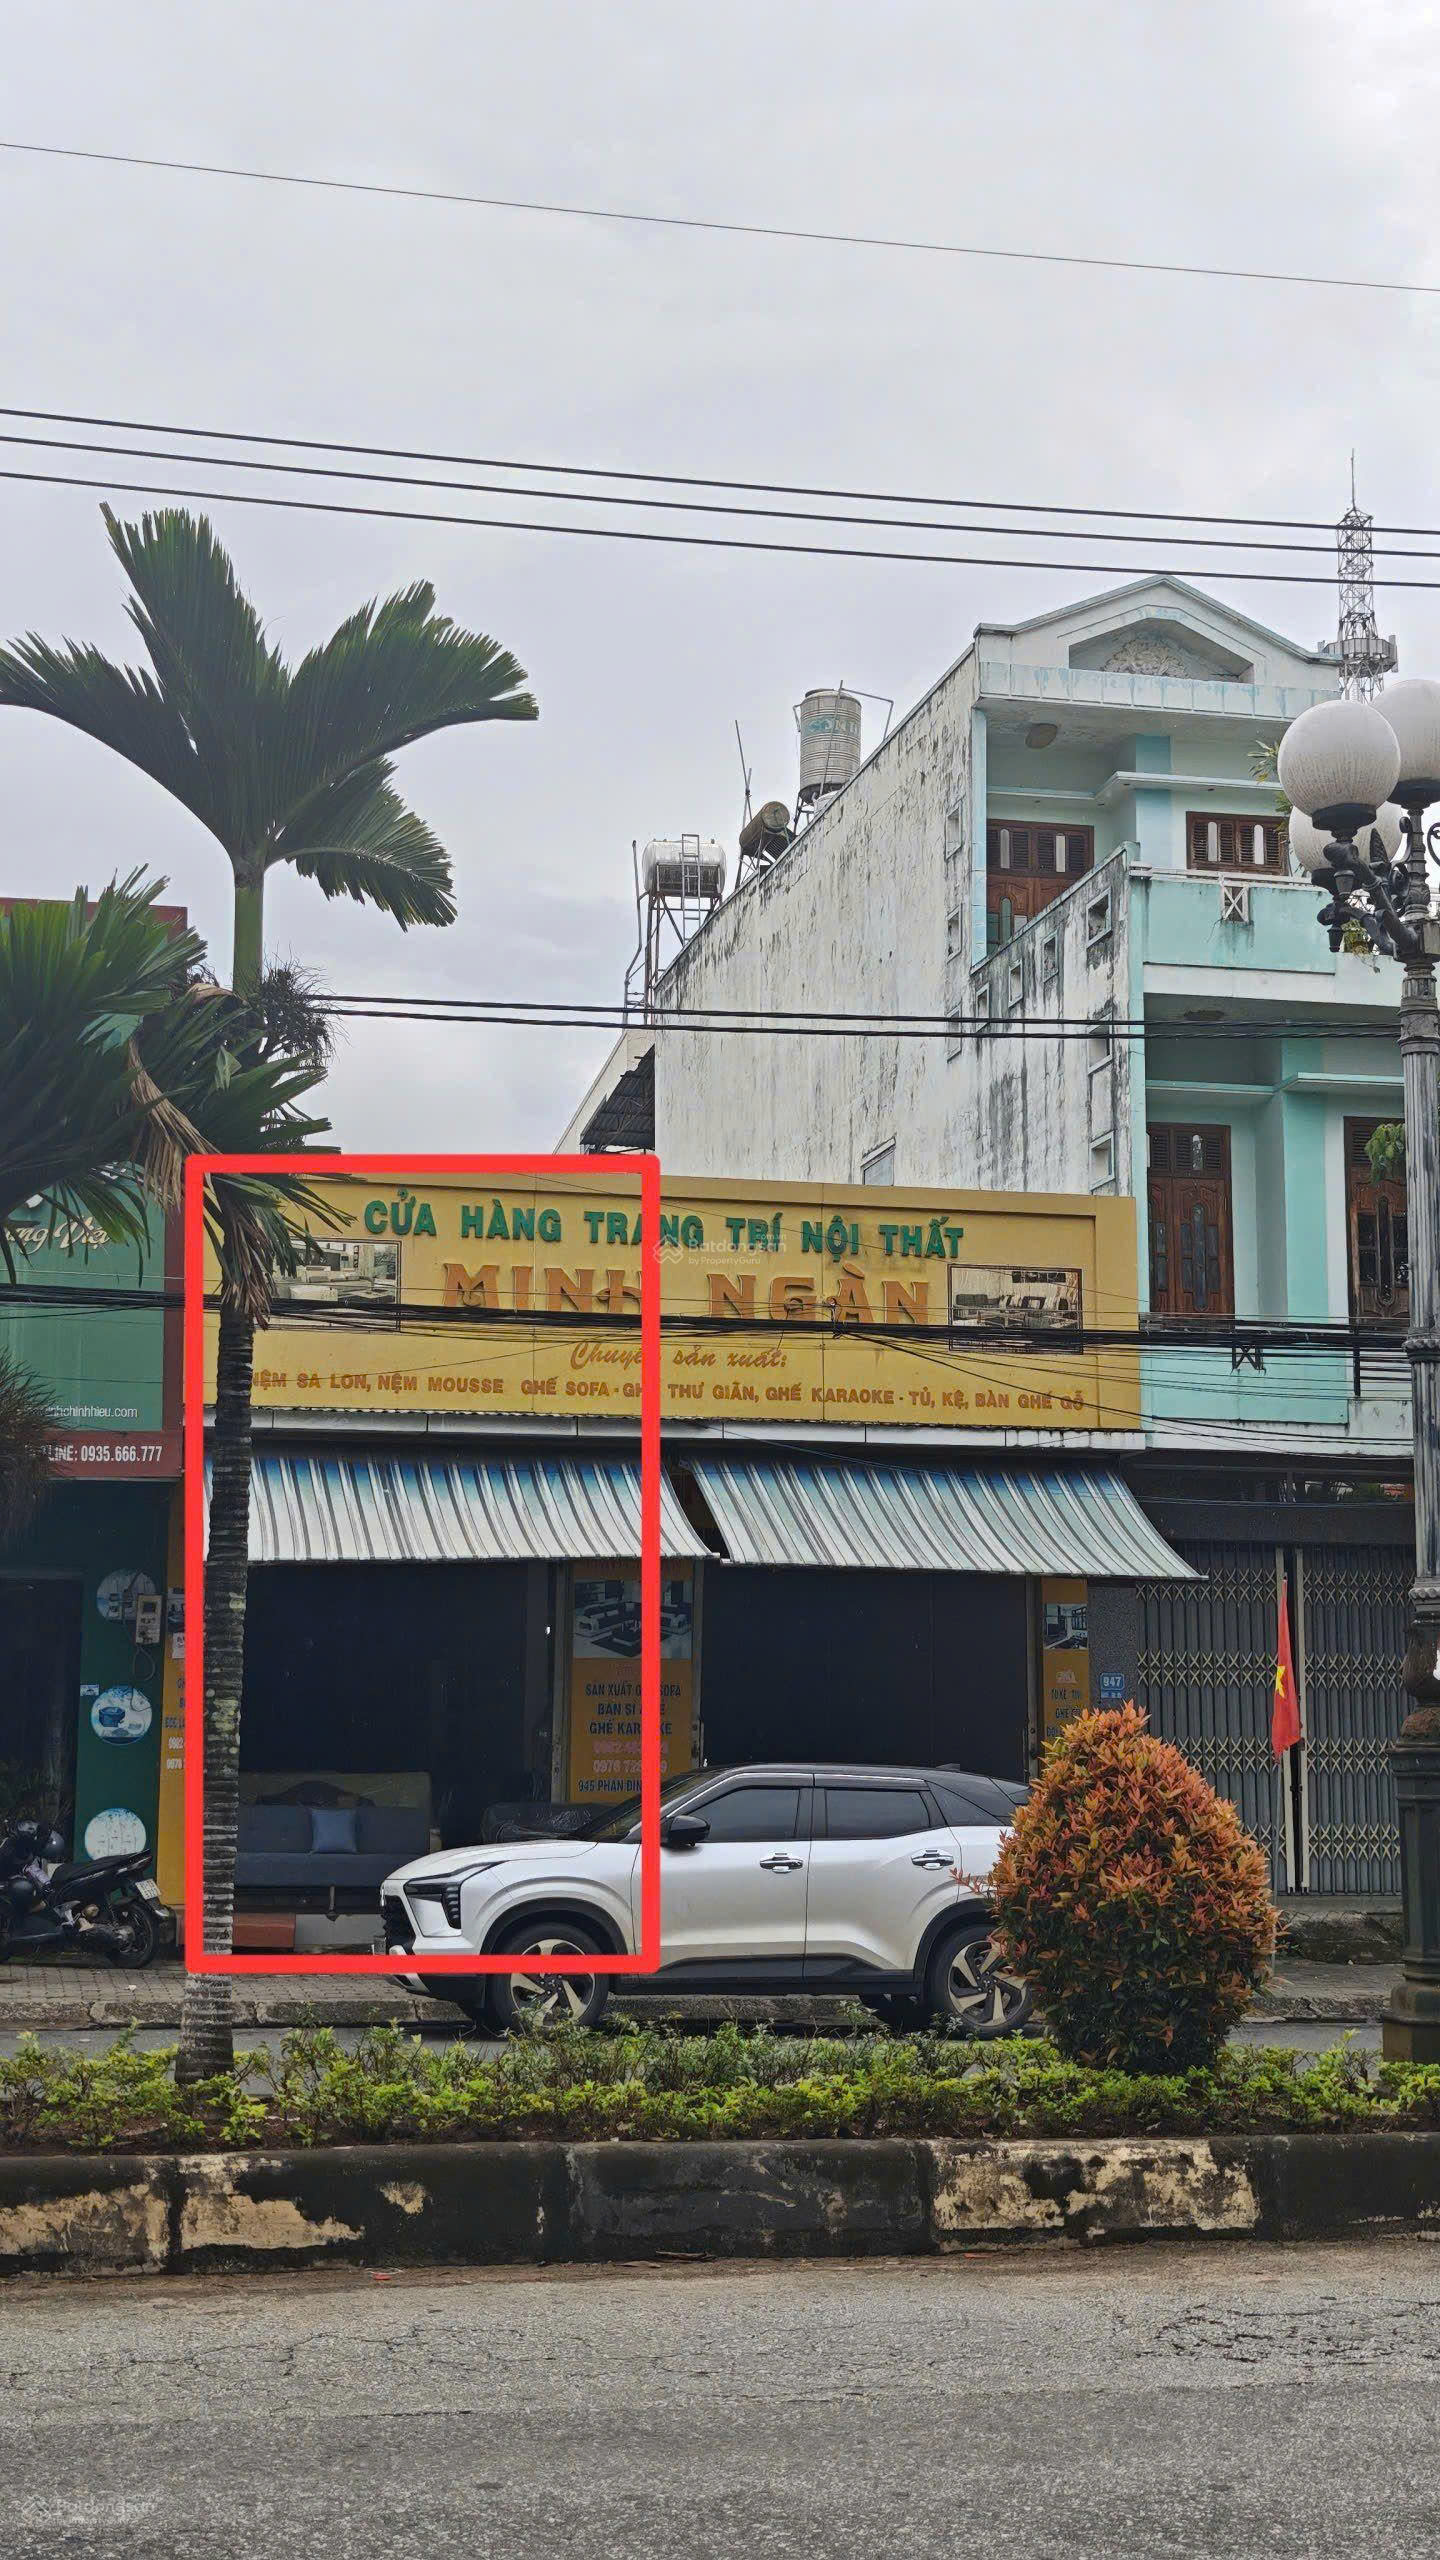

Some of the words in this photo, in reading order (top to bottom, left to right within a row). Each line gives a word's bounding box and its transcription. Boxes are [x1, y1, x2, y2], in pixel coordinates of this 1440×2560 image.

[364, 1189, 437, 1236] CỬA
[461, 1199, 562, 1242] HÀNG
[725, 1213, 787, 1254] TRÍ
[801, 1215, 860, 1263] NỘI
[878, 1216, 965, 1259] THẤT
[442, 1262, 642, 1316] MINH
[707, 1262, 930, 1325] NGÀN
[570, 1342, 645, 1370] Chuyê
[672, 1345, 717, 1369] sản
[727, 1347, 788, 1368] xuất:
[296, 1372, 321, 1389] SA
[378, 1373, 418, 1394] NỆM
[428, 1376, 504, 1394] MOUSSE
[521, 1375, 559, 1396] GHẾ
[667, 1382, 705, 1400] THƯ
[712, 1381, 760, 1403] GIÃN,
[765, 1382, 802, 1402] GHẾ
[811, 1386, 894, 1405] KARAOKE
[908, 1387, 936, 1408] TỦ,
[942, 1389, 969, 1410] KỆ,
[975, 1389, 1010, 1409] BÀN
[1017, 1390, 1053, 1410] GHẾ
[81, 1445, 163, 1463] 0935.666.777
